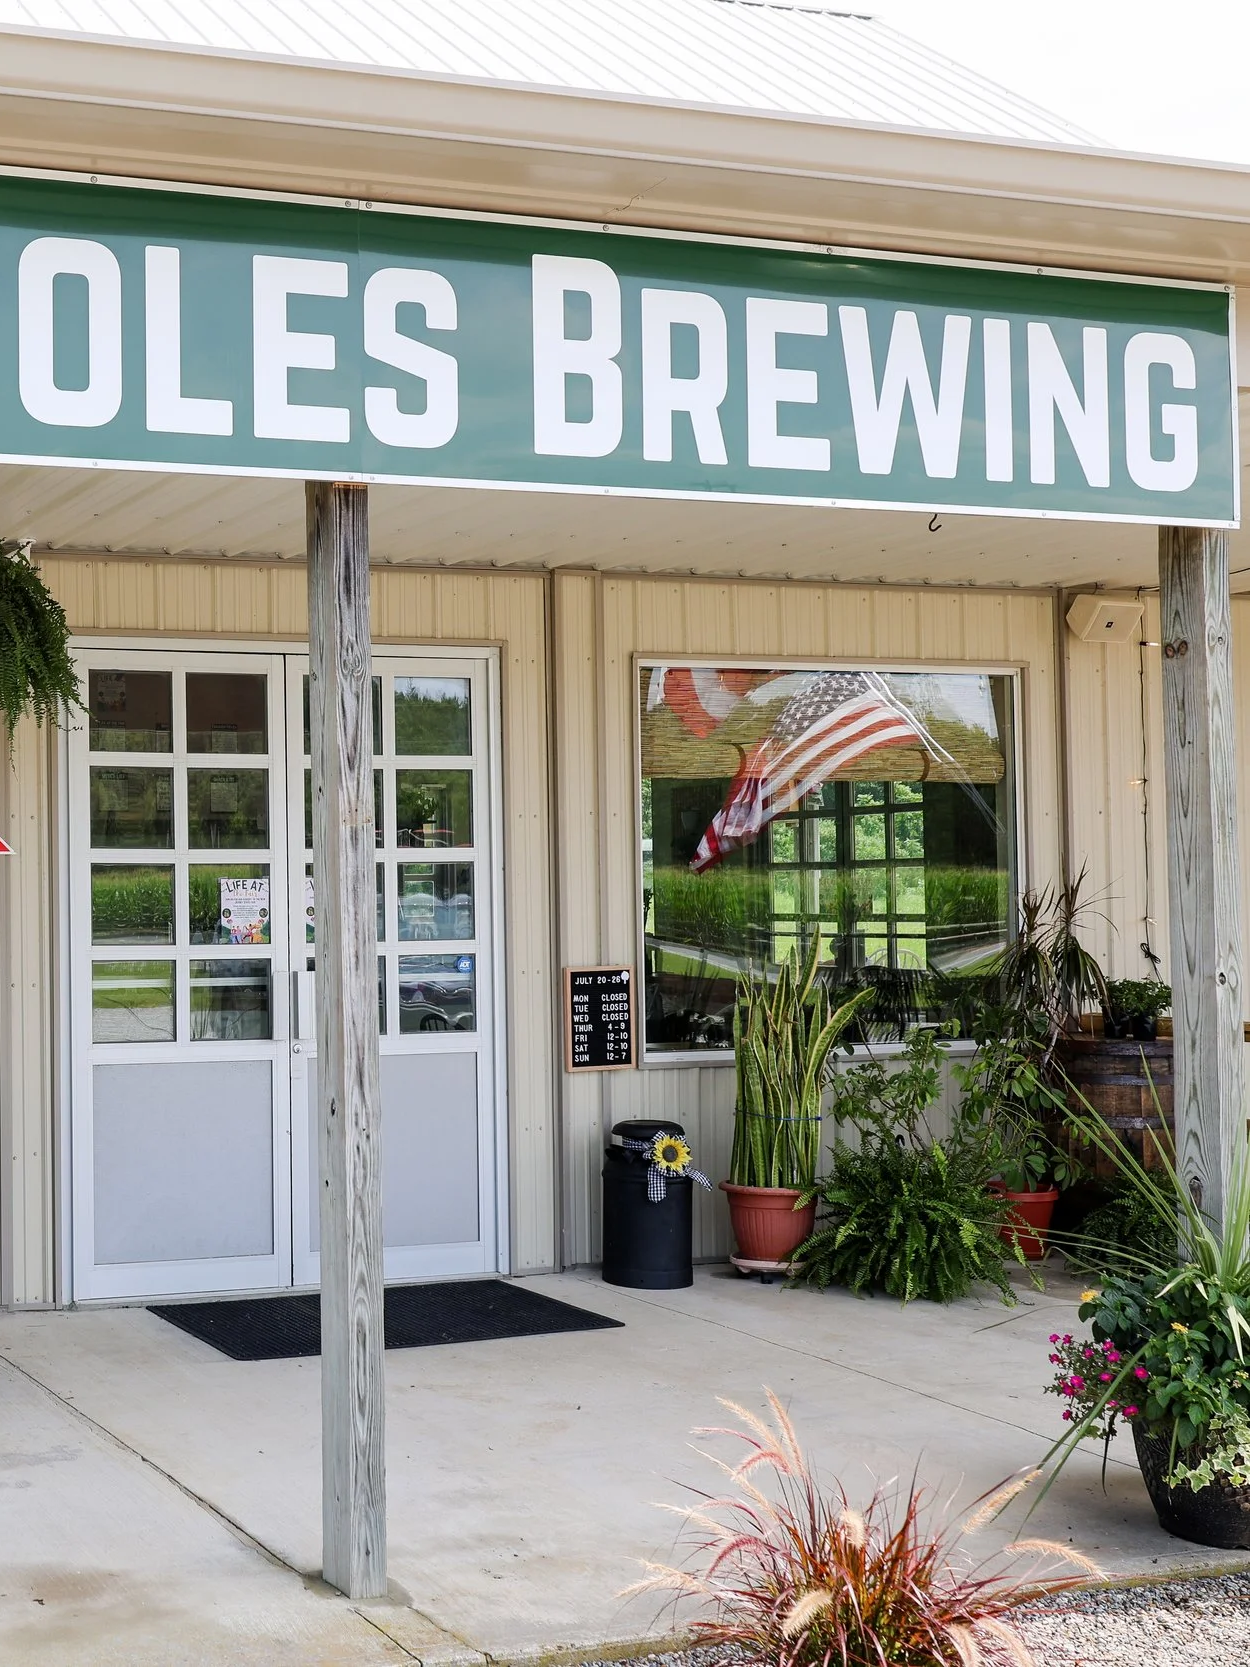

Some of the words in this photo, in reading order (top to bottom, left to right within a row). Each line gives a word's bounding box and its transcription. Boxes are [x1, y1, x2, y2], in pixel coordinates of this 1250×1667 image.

[531, 253, 1199, 493] BREWING
[226, 879, 248, 893] LIFE
[250, 880, 264, 892] AT
[575, 976, 593, 985] JULY
[573, 994, 589, 1003] MON
[601, 993, 628, 1002] CLOSED
[574, 1004, 589, 1013] TUE
[601, 1003, 629, 1012] CLOSED
[573, 1014, 590, 1023] WED
[601, 1013, 629, 1021] CLOSED
[574, 1024, 594, 1032] THUR
[575, 1034, 588, 1043] FRI
[574, 1044, 589, 1052] SAT
[574, 1054, 590, 1062] SUN
